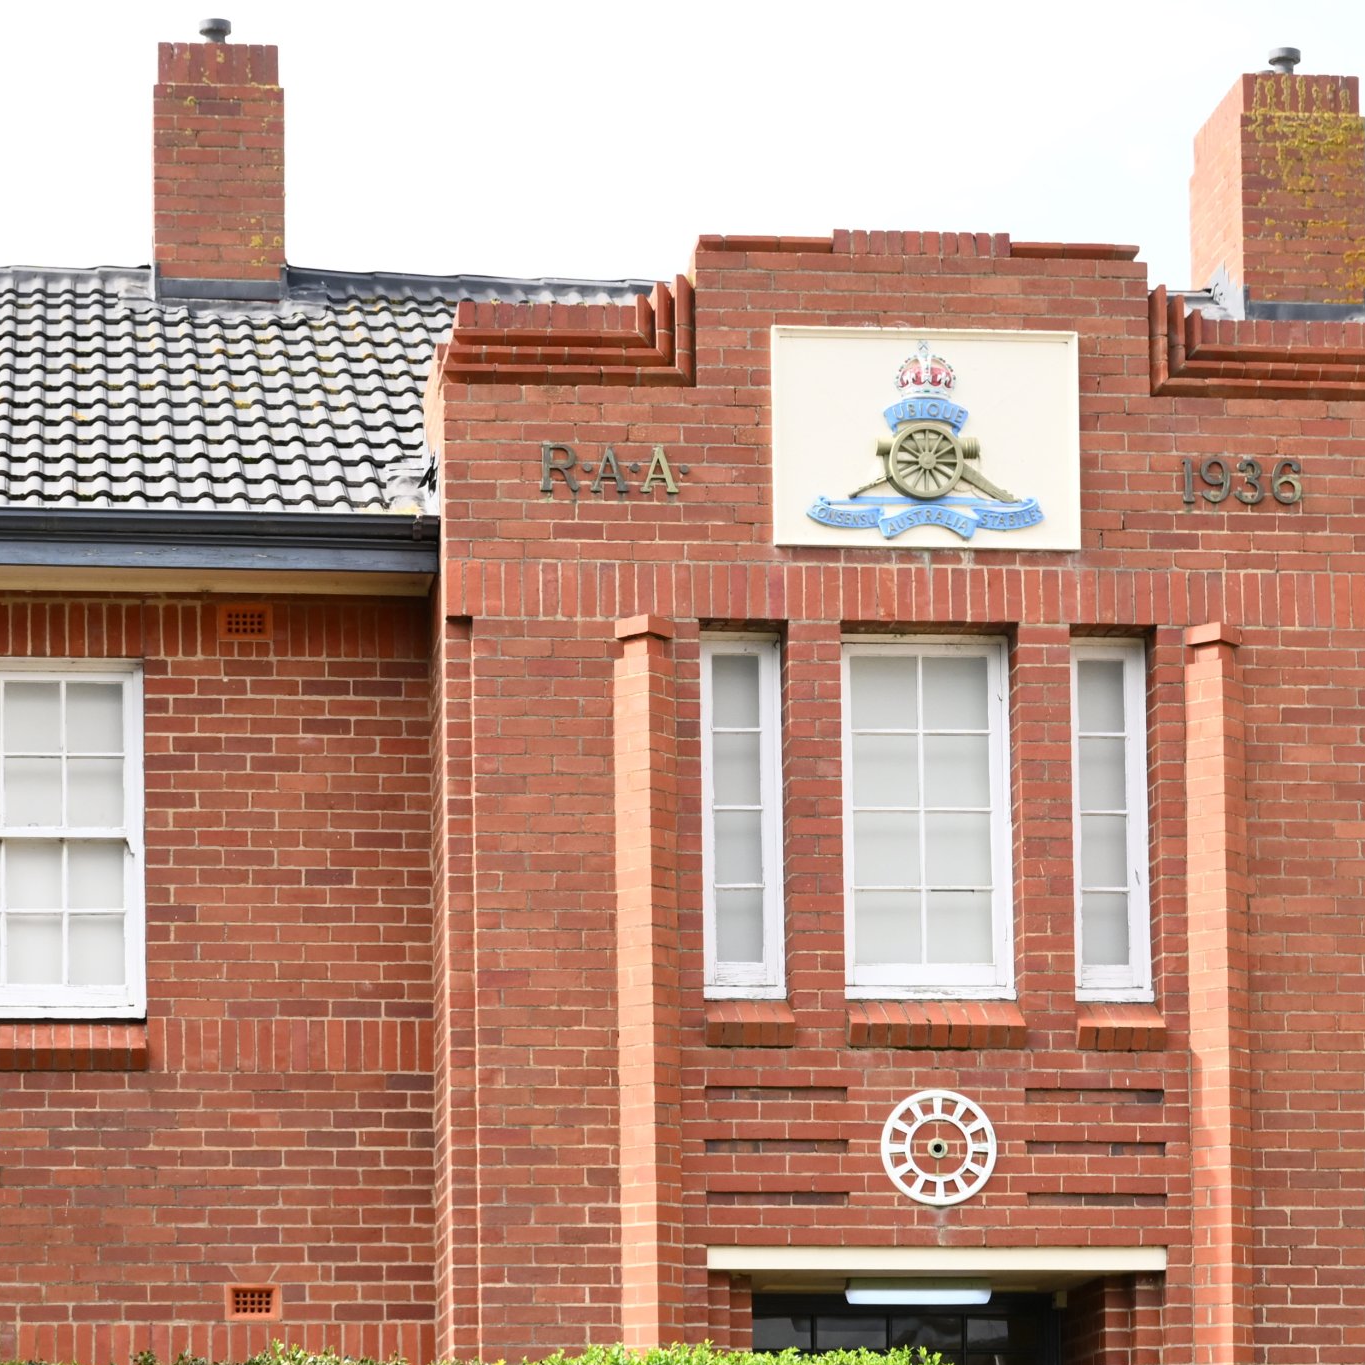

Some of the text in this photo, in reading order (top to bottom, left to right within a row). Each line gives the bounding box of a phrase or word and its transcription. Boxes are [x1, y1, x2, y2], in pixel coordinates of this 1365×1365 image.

[892, 401, 965, 424] UBIQUE
[1181, 458, 1304, 505] 1936
[811, 504, 1044, 534] CONSENSU AUSTRALIA STABILES
